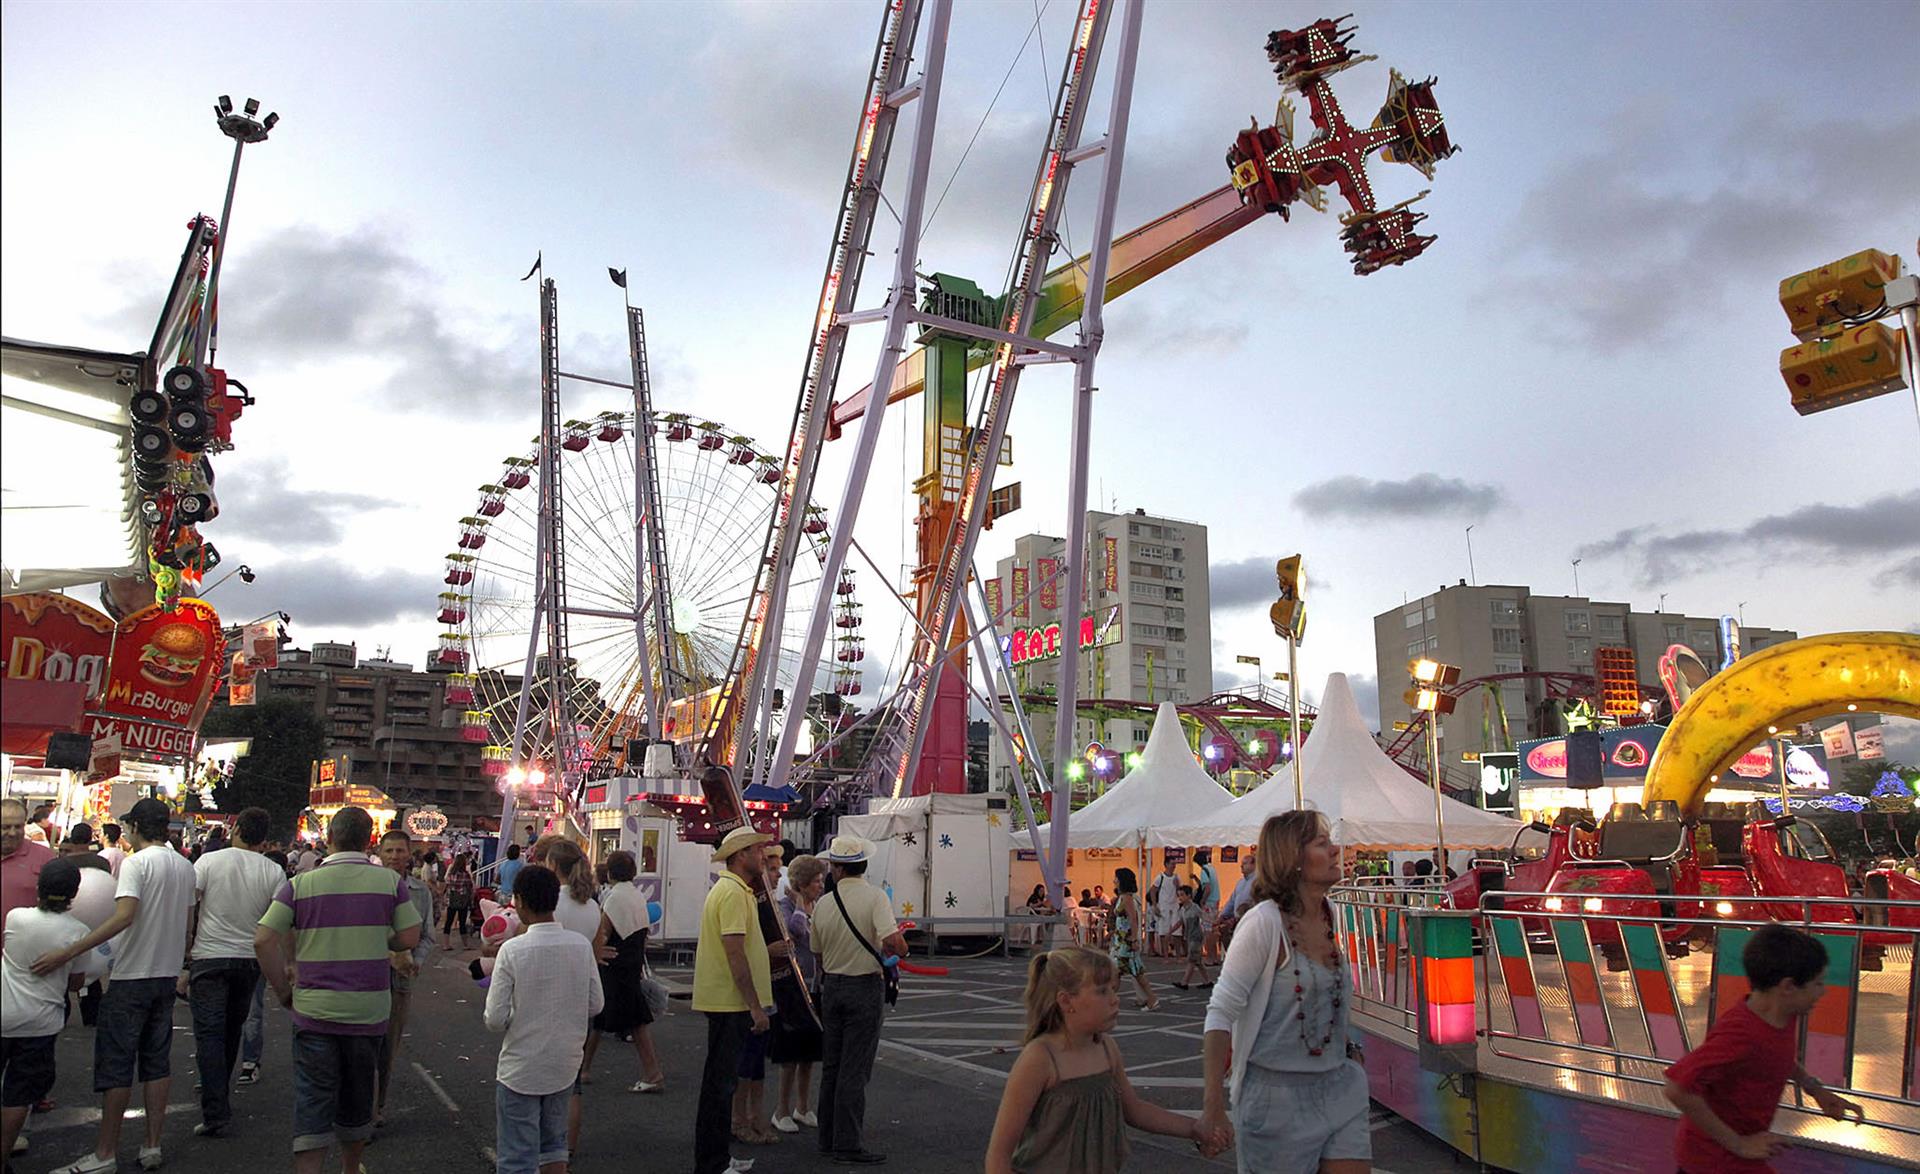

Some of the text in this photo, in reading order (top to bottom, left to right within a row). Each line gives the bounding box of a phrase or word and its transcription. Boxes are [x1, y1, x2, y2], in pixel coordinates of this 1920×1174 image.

[1012, 615, 1094, 664] RATN
[7, 636, 104, 700] Dog
[125, 723, 193, 753] NUGGE
